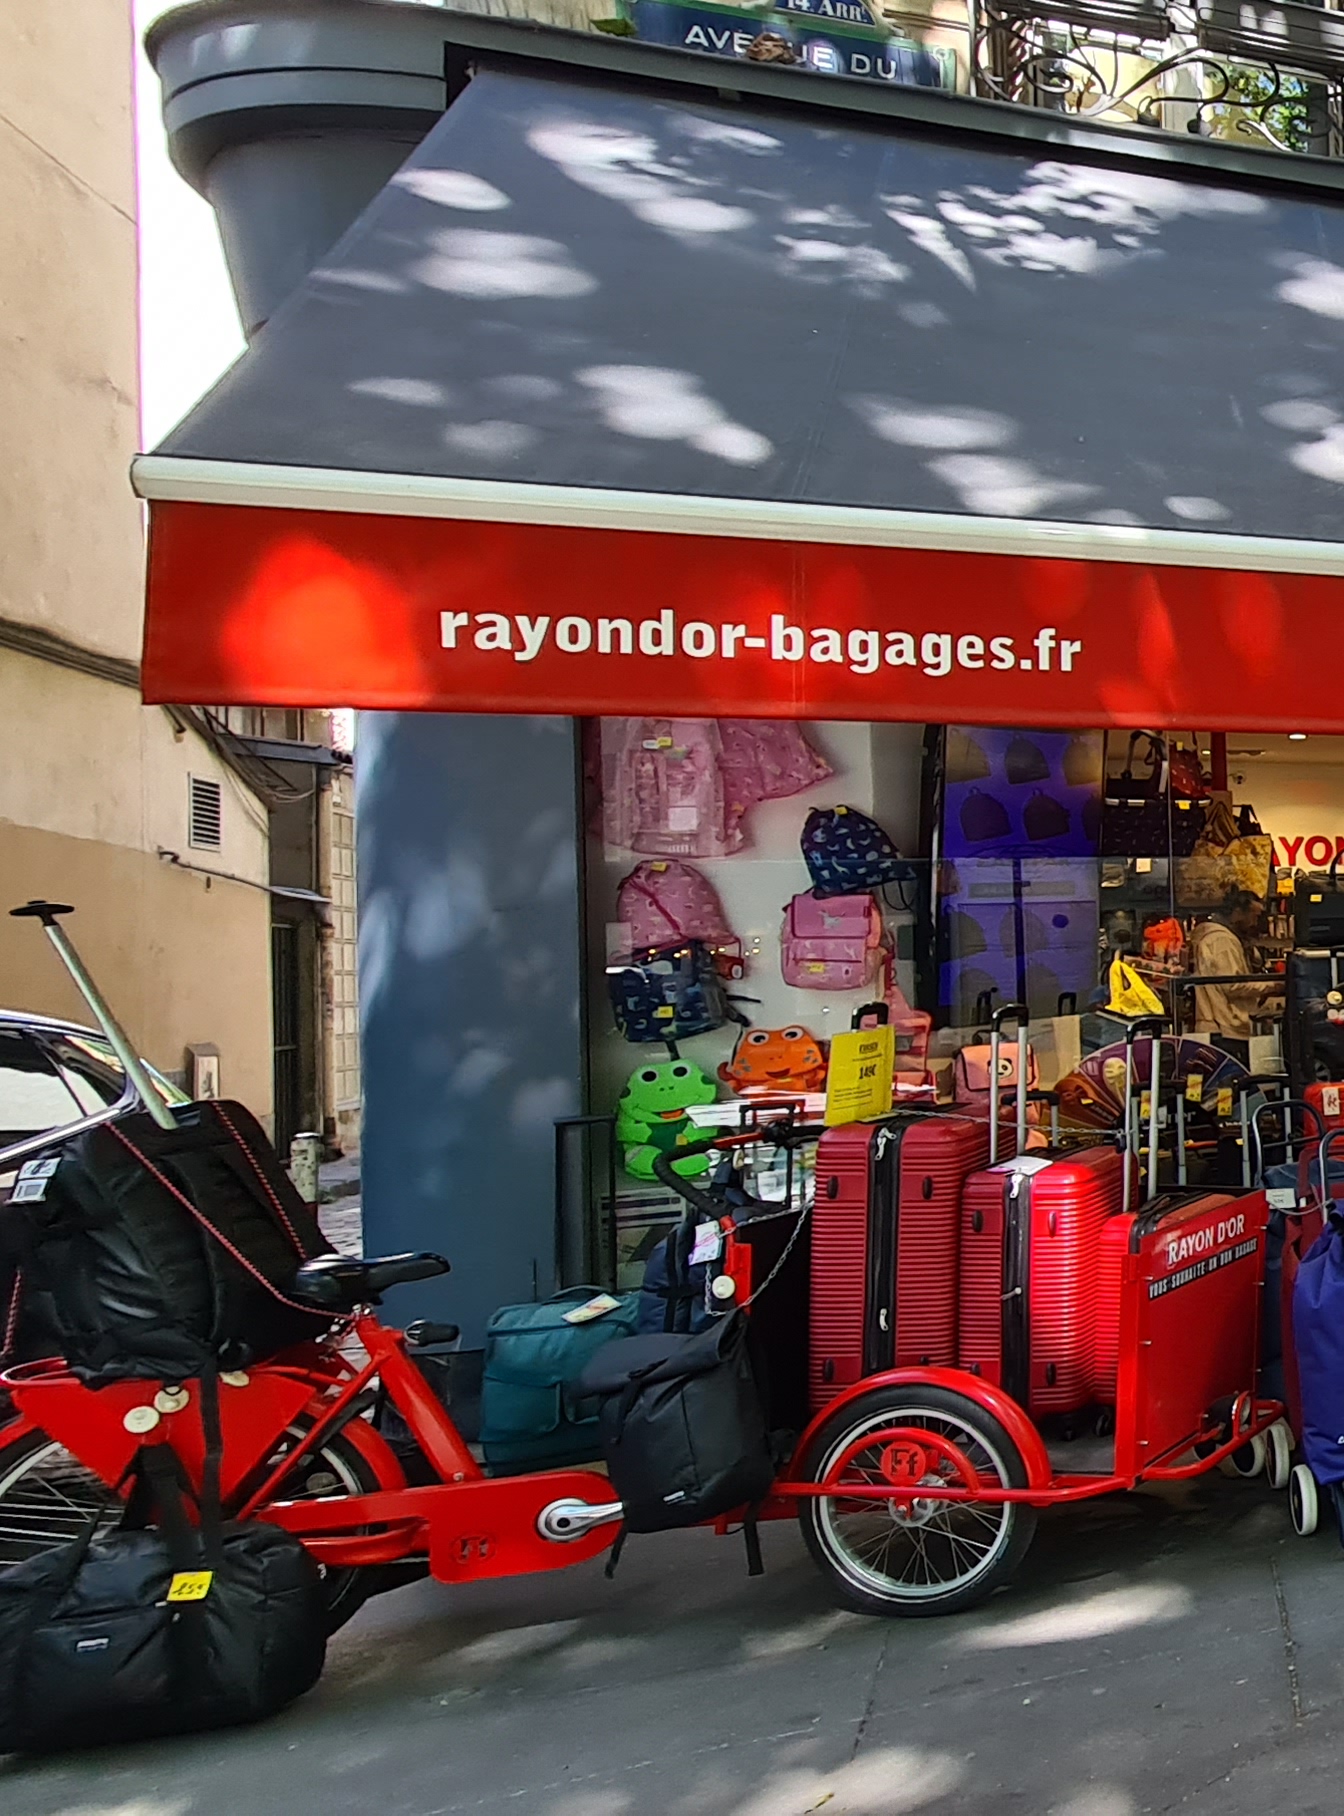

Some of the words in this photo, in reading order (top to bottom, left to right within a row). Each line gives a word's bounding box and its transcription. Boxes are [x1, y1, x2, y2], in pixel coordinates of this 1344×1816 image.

[851, 53, 897, 79] DU
[439, 609, 1083, 676] rayondor-bagages.fr
[1167, 1226, 1214, 1266] RAYON
[1217, 1213, 1245, 1244] D'OR
[1149, 1278, 1168, 1299] VOUS
[1171, 1261, 1206, 1288] SOUHAITE
